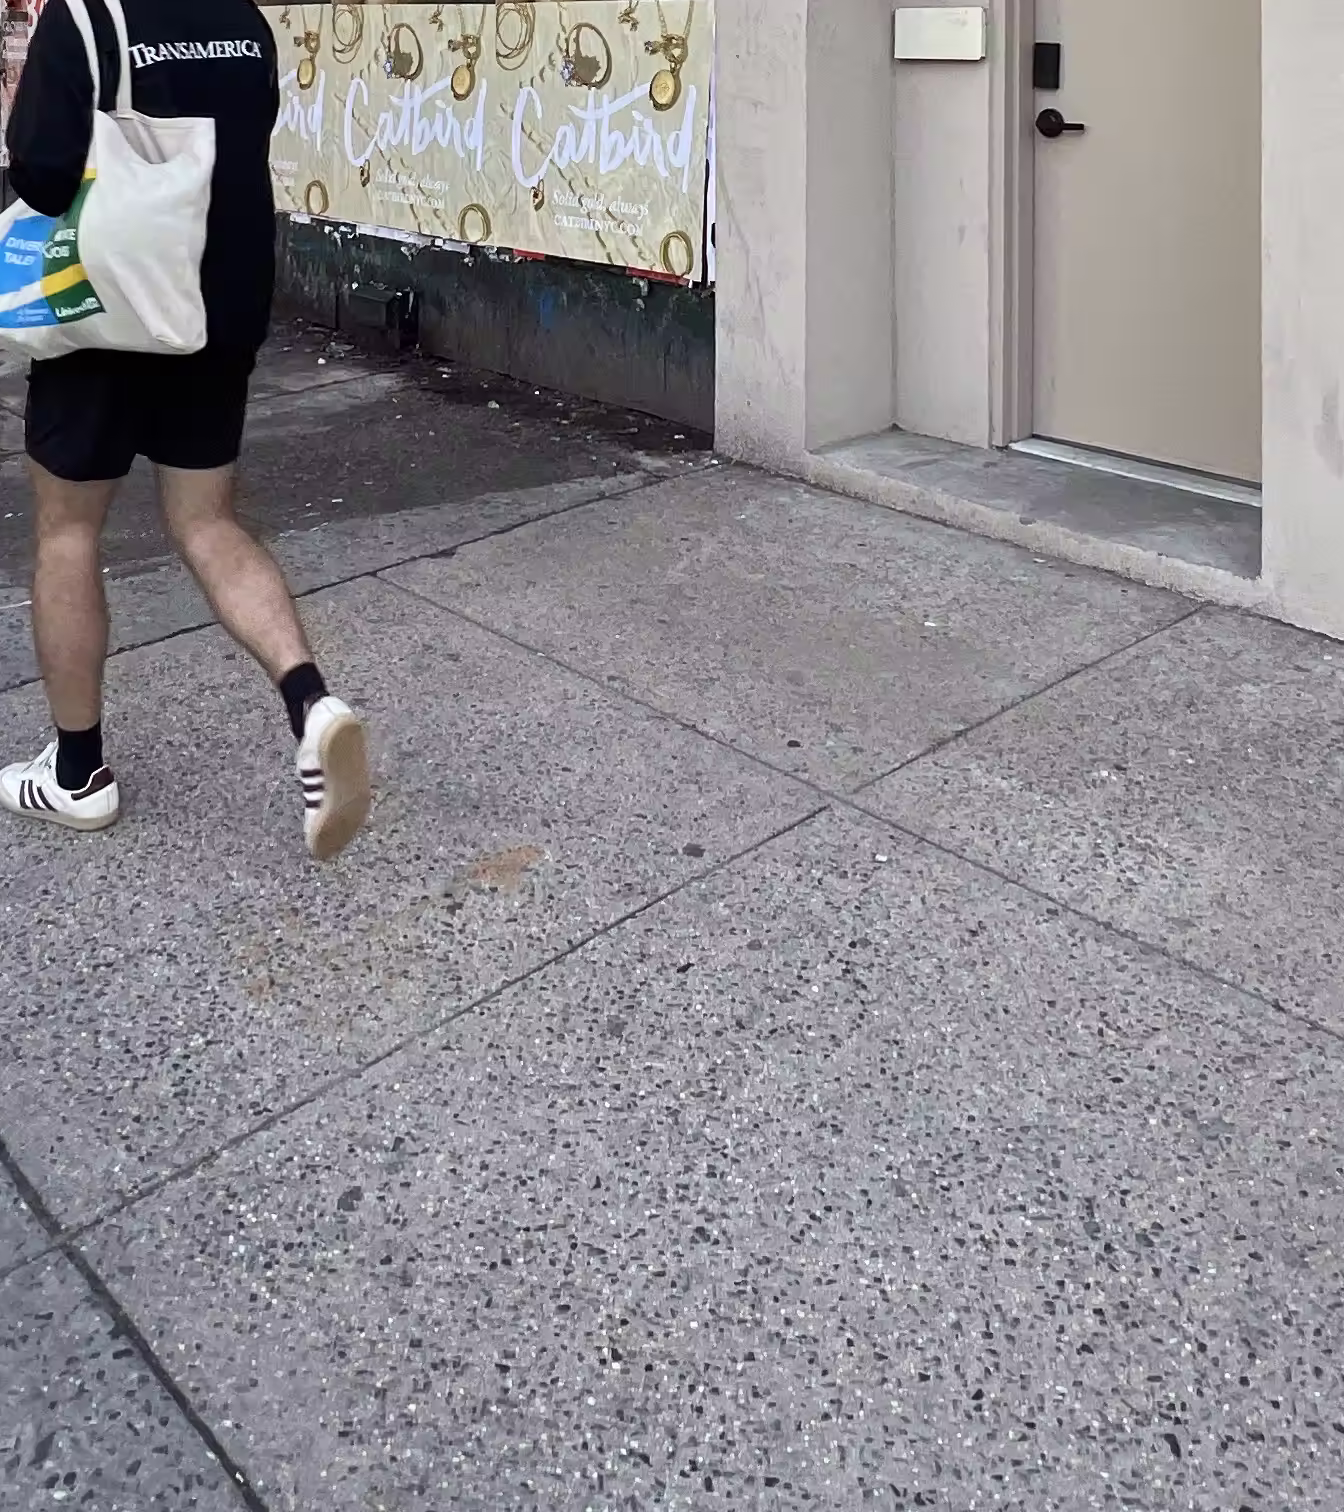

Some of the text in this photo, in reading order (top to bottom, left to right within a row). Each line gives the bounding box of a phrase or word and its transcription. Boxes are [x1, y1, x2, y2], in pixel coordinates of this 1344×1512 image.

[128, 39, 262, 68] TRANSAMERICA
[344, 76, 487, 172] Catbird
[511, 84, 697, 194] Catbird
